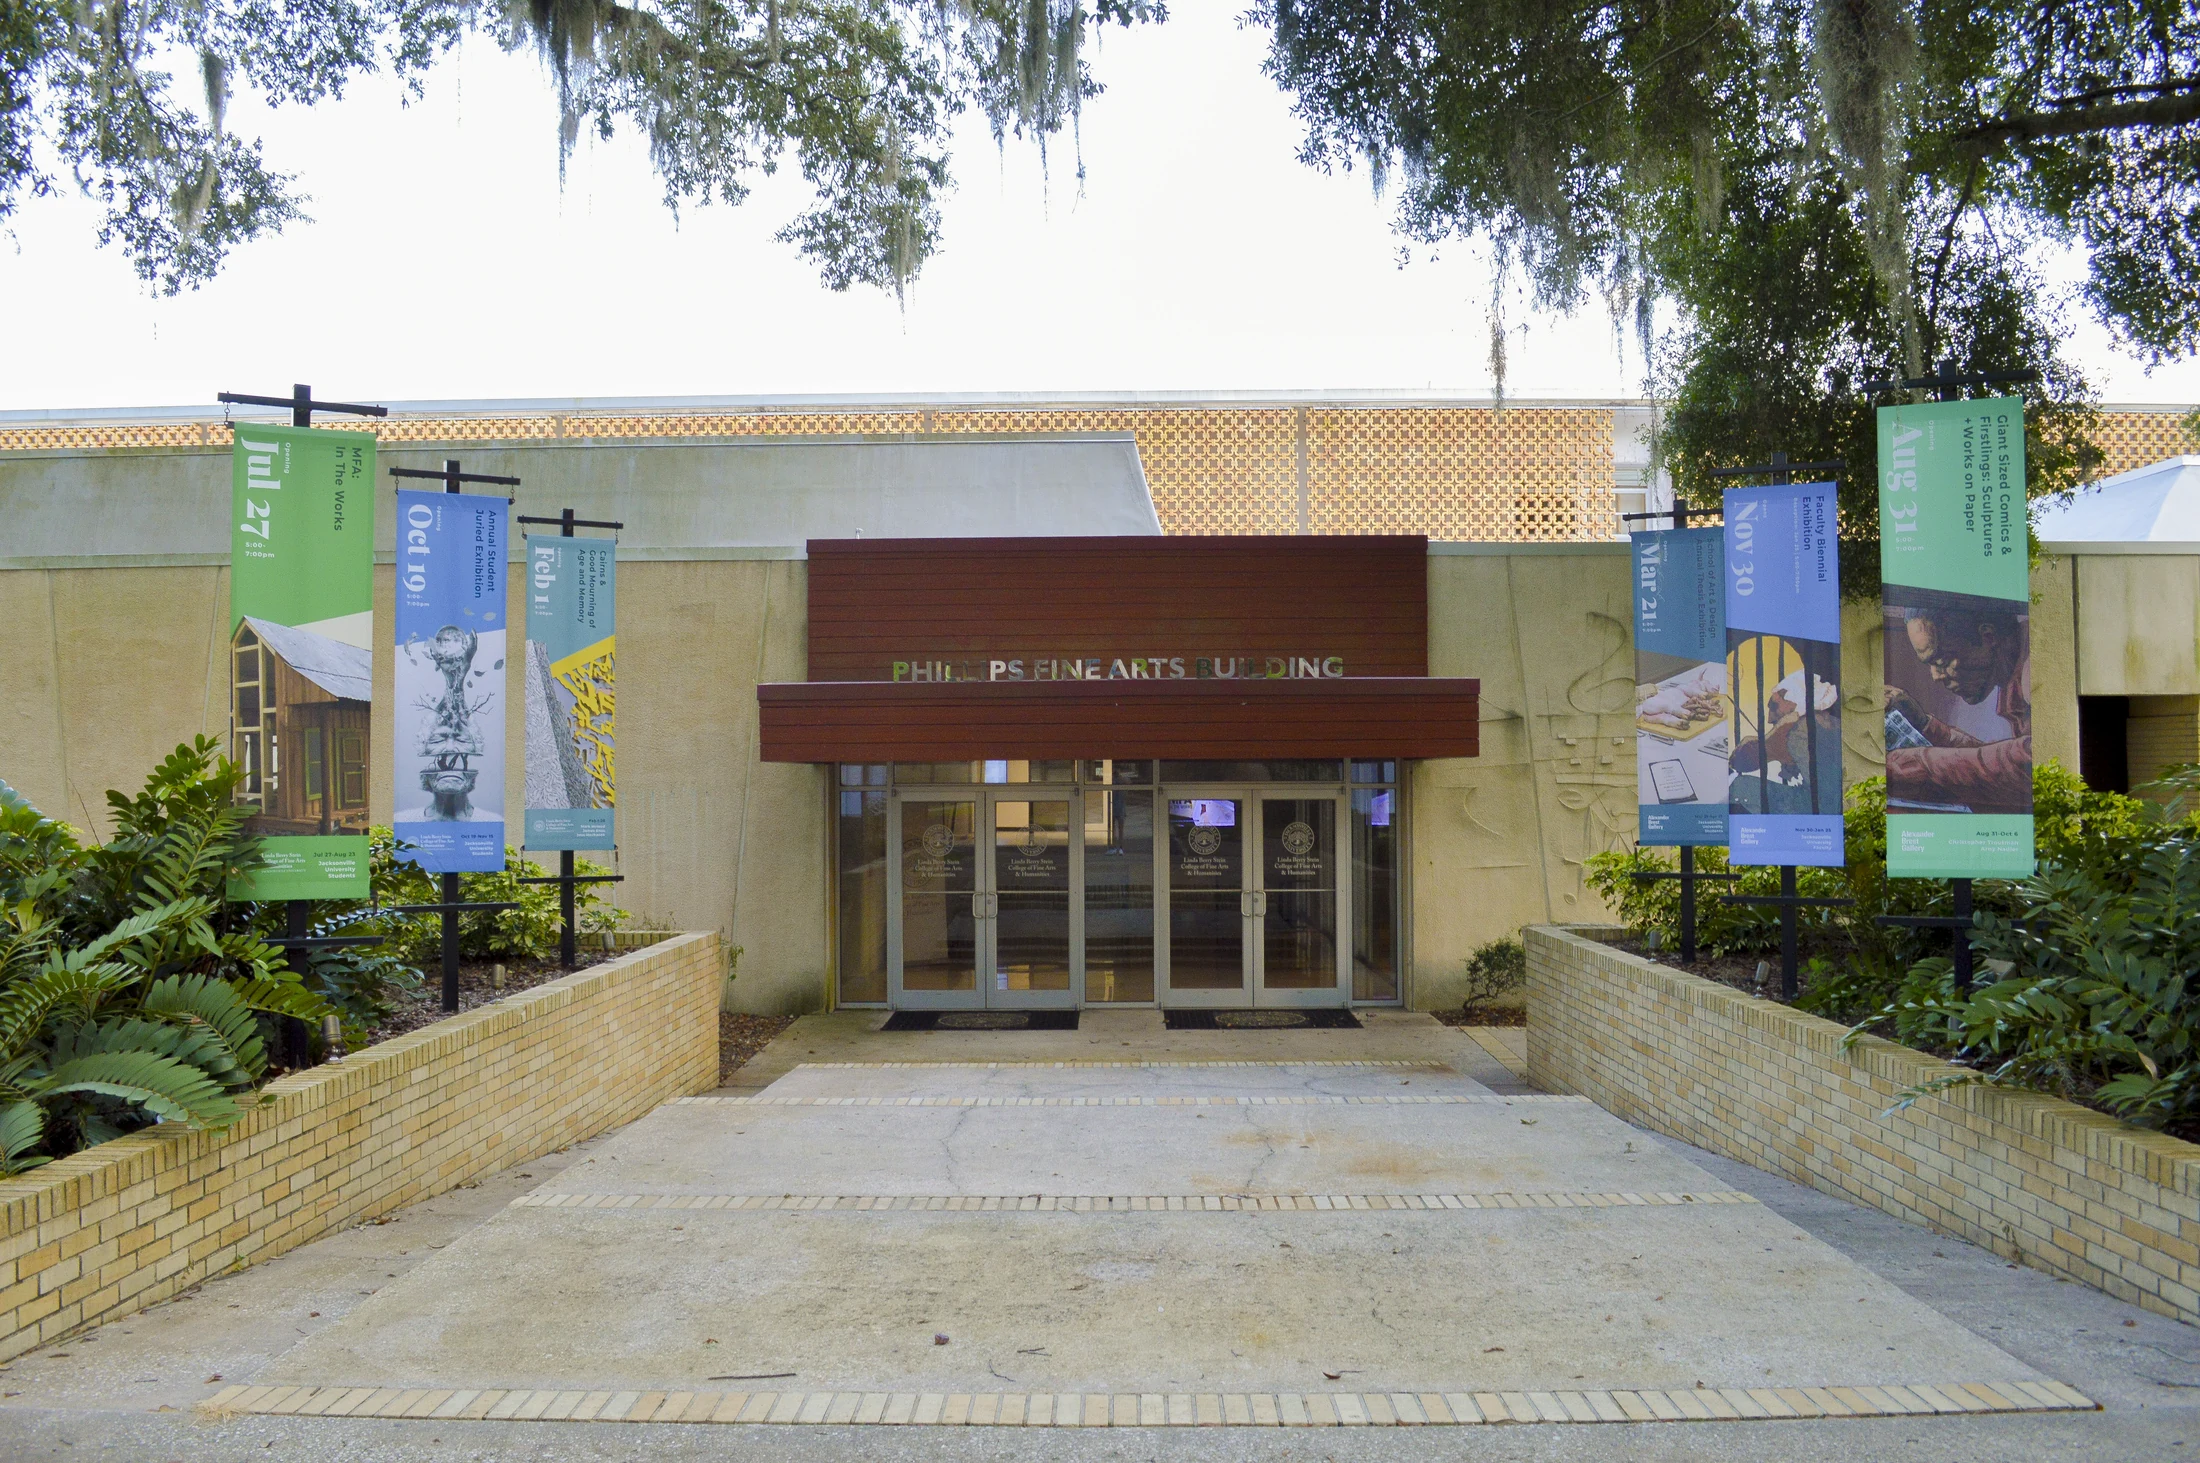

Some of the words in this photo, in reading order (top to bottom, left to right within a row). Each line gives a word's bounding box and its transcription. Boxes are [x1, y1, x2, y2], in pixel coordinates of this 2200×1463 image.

[1963, 426, 1974, 469] Works
[1979, 416, 1992, 482] Firstlings:
[1998, 415, 2009, 450] Giant
[241, 436, 281, 490] Jul
[336, 446, 346, 458] In
[352, 448, 362, 478] MFA:
[1886, 421, 1922, 492] Aug
[336, 463, 346, 486] The
[1965, 473, 1972, 489] on
[1999, 455, 2010, 489] Sized
[240, 498, 270, 540] 27
[334, 491, 344, 531] Works
[476, 509, 484, 542] Juried
[488, 510, 496, 547] Annual
[1734, 501, 1758, 555] Nov
[1803, 496, 1812, 550] Exhibition
[1815, 496, 1825, 535] Faculty
[1889, 500, 1918, 534] 31
[1964, 494, 1975, 532] Paper
[1981, 486, 1994, 557] Sculptures
[2000, 494, 2012, 542] Comics
[408, 504, 433, 556] Oct
[535, 546, 556, 588] Feb
[1641, 543, 1660, 592] Mar
[1818, 539, 1827, 582] Biennial
[2002, 547, 2011, 555] &
[403, 563, 426, 592] 19
[474, 545, 484, 598] Exhibition
[488, 550, 496, 592] Student
[1708, 571, 1716, 581] of
[1731, 561, 1754, 596] 30
[535, 595, 549, 603] 1
[577, 588, 585, 623] Memory
[588, 576, 596, 617] Mourning
[1642, 597, 1657, 620] 21
[589, 620, 596, 628] of
[1708, 608, 1717, 638] Design
[893, 659, 1024, 682] PHILLIPS
[1034, 659, 1101, 681] FINE
[1108, 657, 1185, 680] ARTS
[1196, 656, 1344, 679] BUILDING
